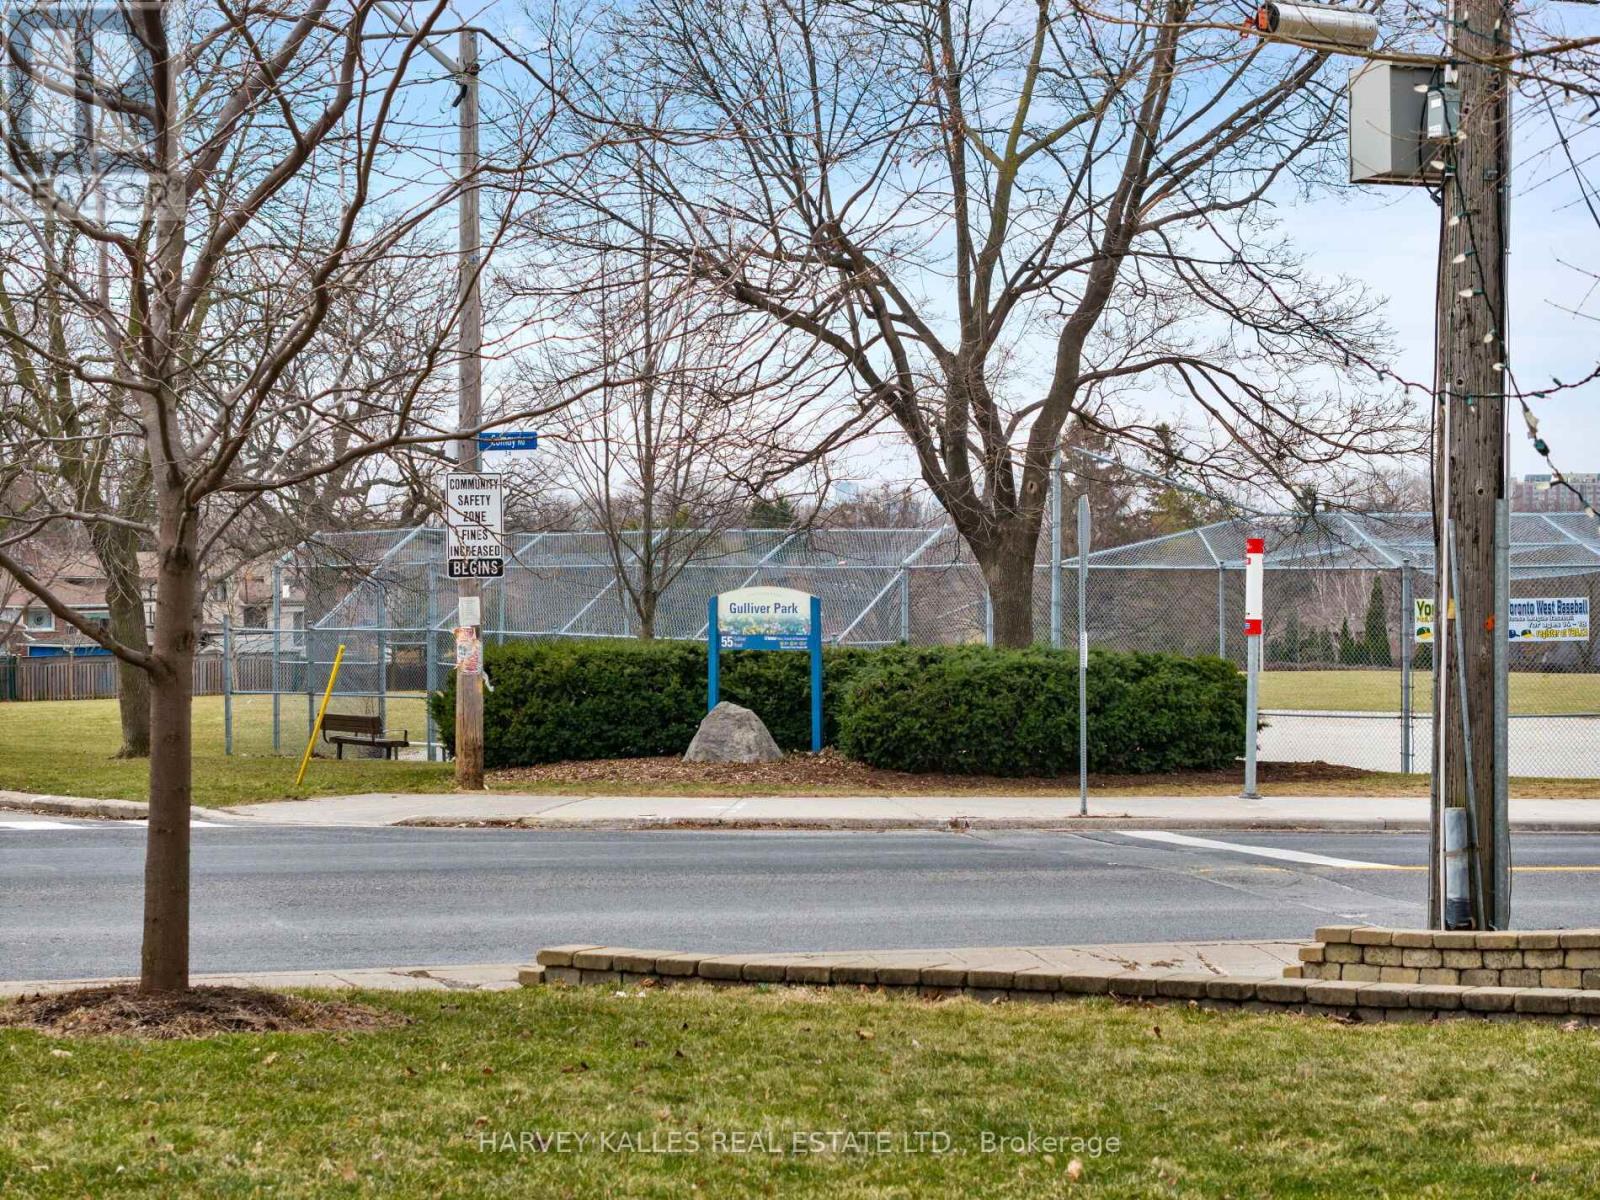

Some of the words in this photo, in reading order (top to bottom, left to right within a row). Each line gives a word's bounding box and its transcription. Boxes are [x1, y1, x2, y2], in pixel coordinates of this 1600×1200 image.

[449, 478, 499, 490] COMMUNITY
[457, 494, 491, 506] SAFETY
[463, 511, 487, 522] ZONE
[461, 529, 488, 541] FINES
[450, 545, 500, 557] INCREASED
[453, 560, 499, 575] BEGINS
[729, 602, 770, 614] Gulliver
[774, 602, 798, 614] Park
[1509, 602, 1535, 615] oronto
[1536, 600, 1555, 615] West
[1557, 599, 1588, 615] Baseball
[721, 636, 734, 648] 55
